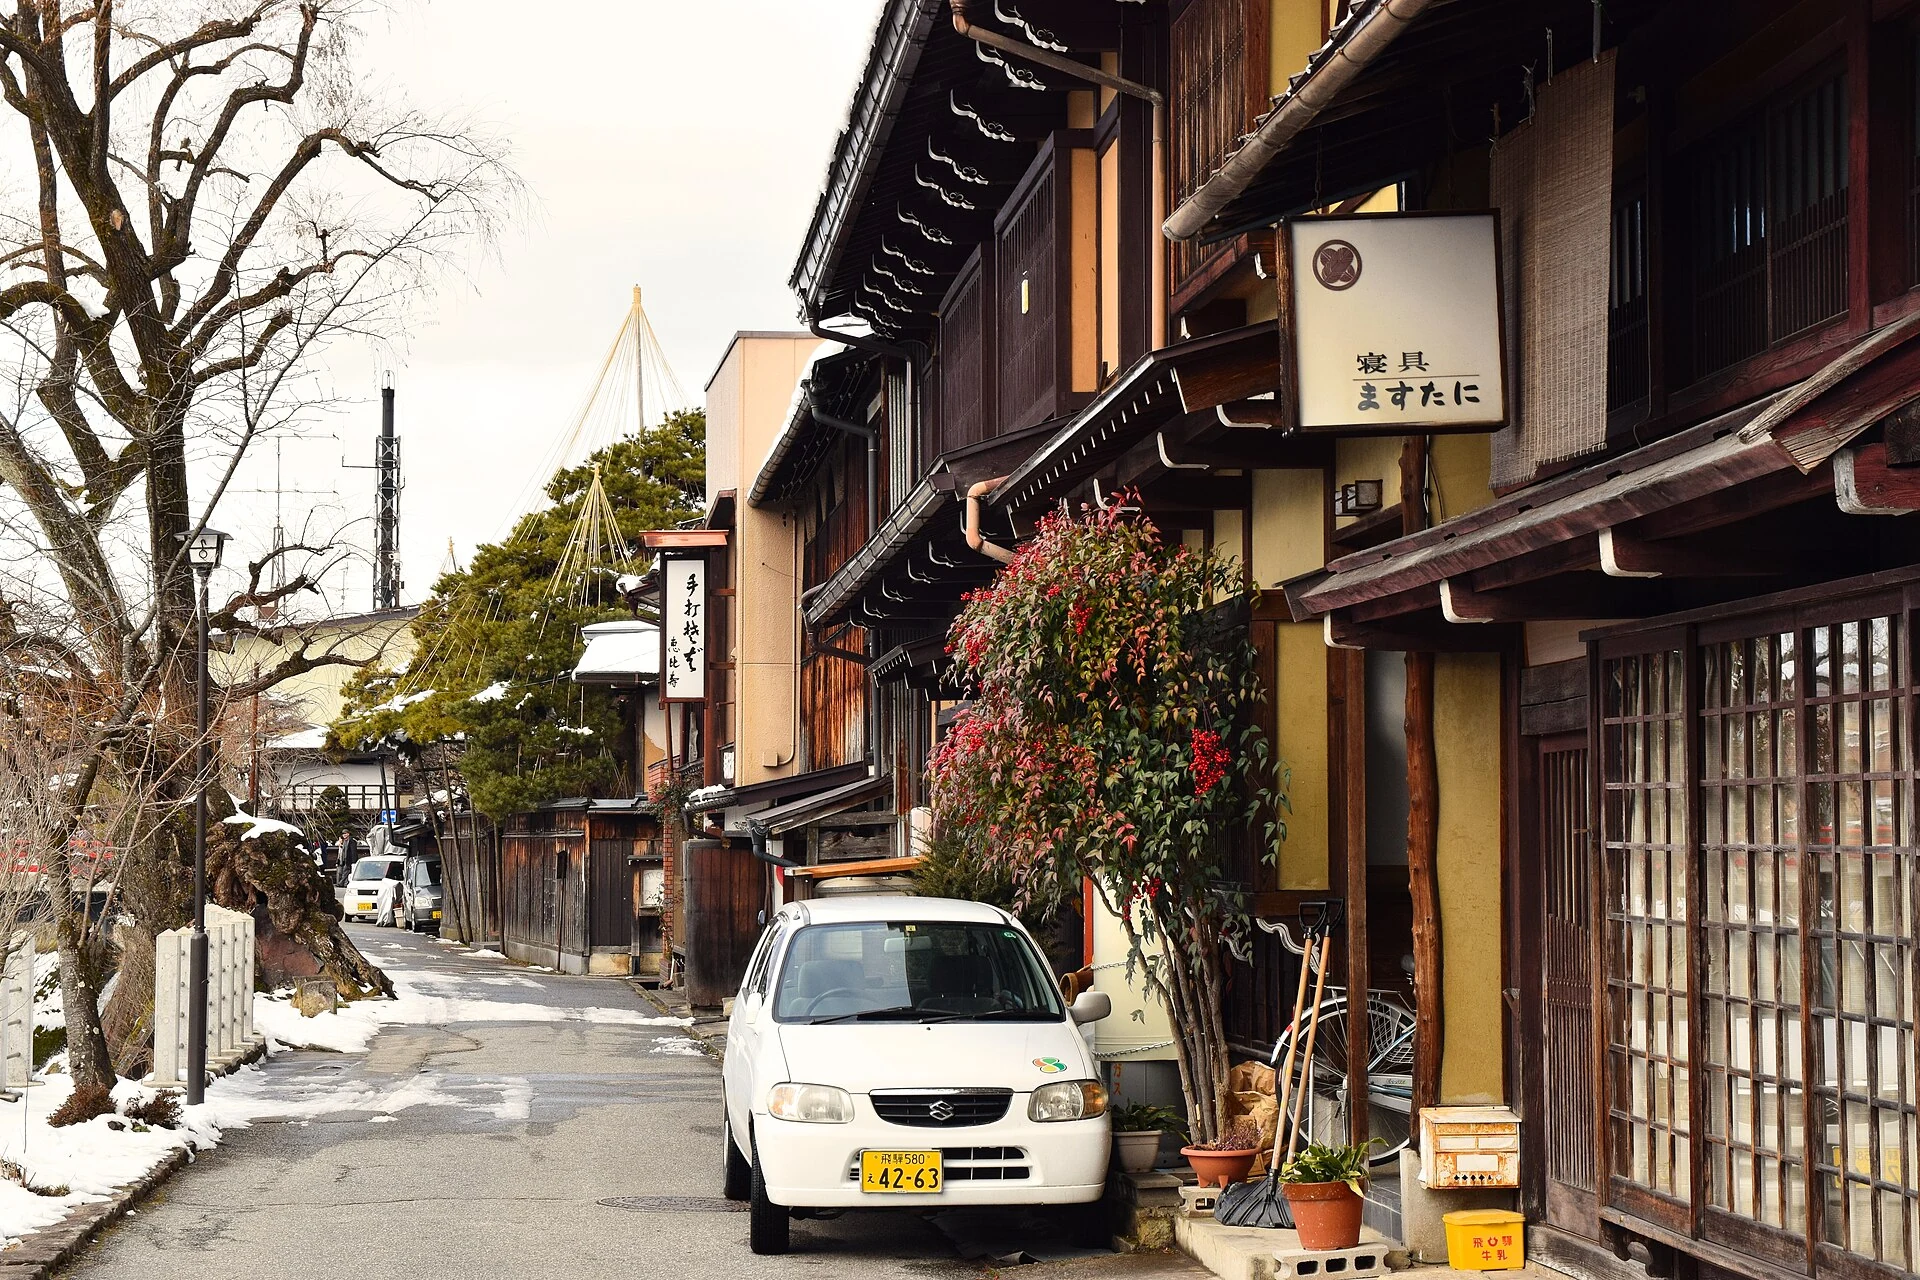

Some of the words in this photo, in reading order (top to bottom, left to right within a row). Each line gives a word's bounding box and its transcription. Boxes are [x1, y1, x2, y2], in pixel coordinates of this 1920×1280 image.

[1356, 350, 1430, 374] 寝具
[1357, 380, 1481, 412] ますたに
[879, 1167, 939, 1189] 42-63
[1481, 1249, 1508, 1261] 牛乳
